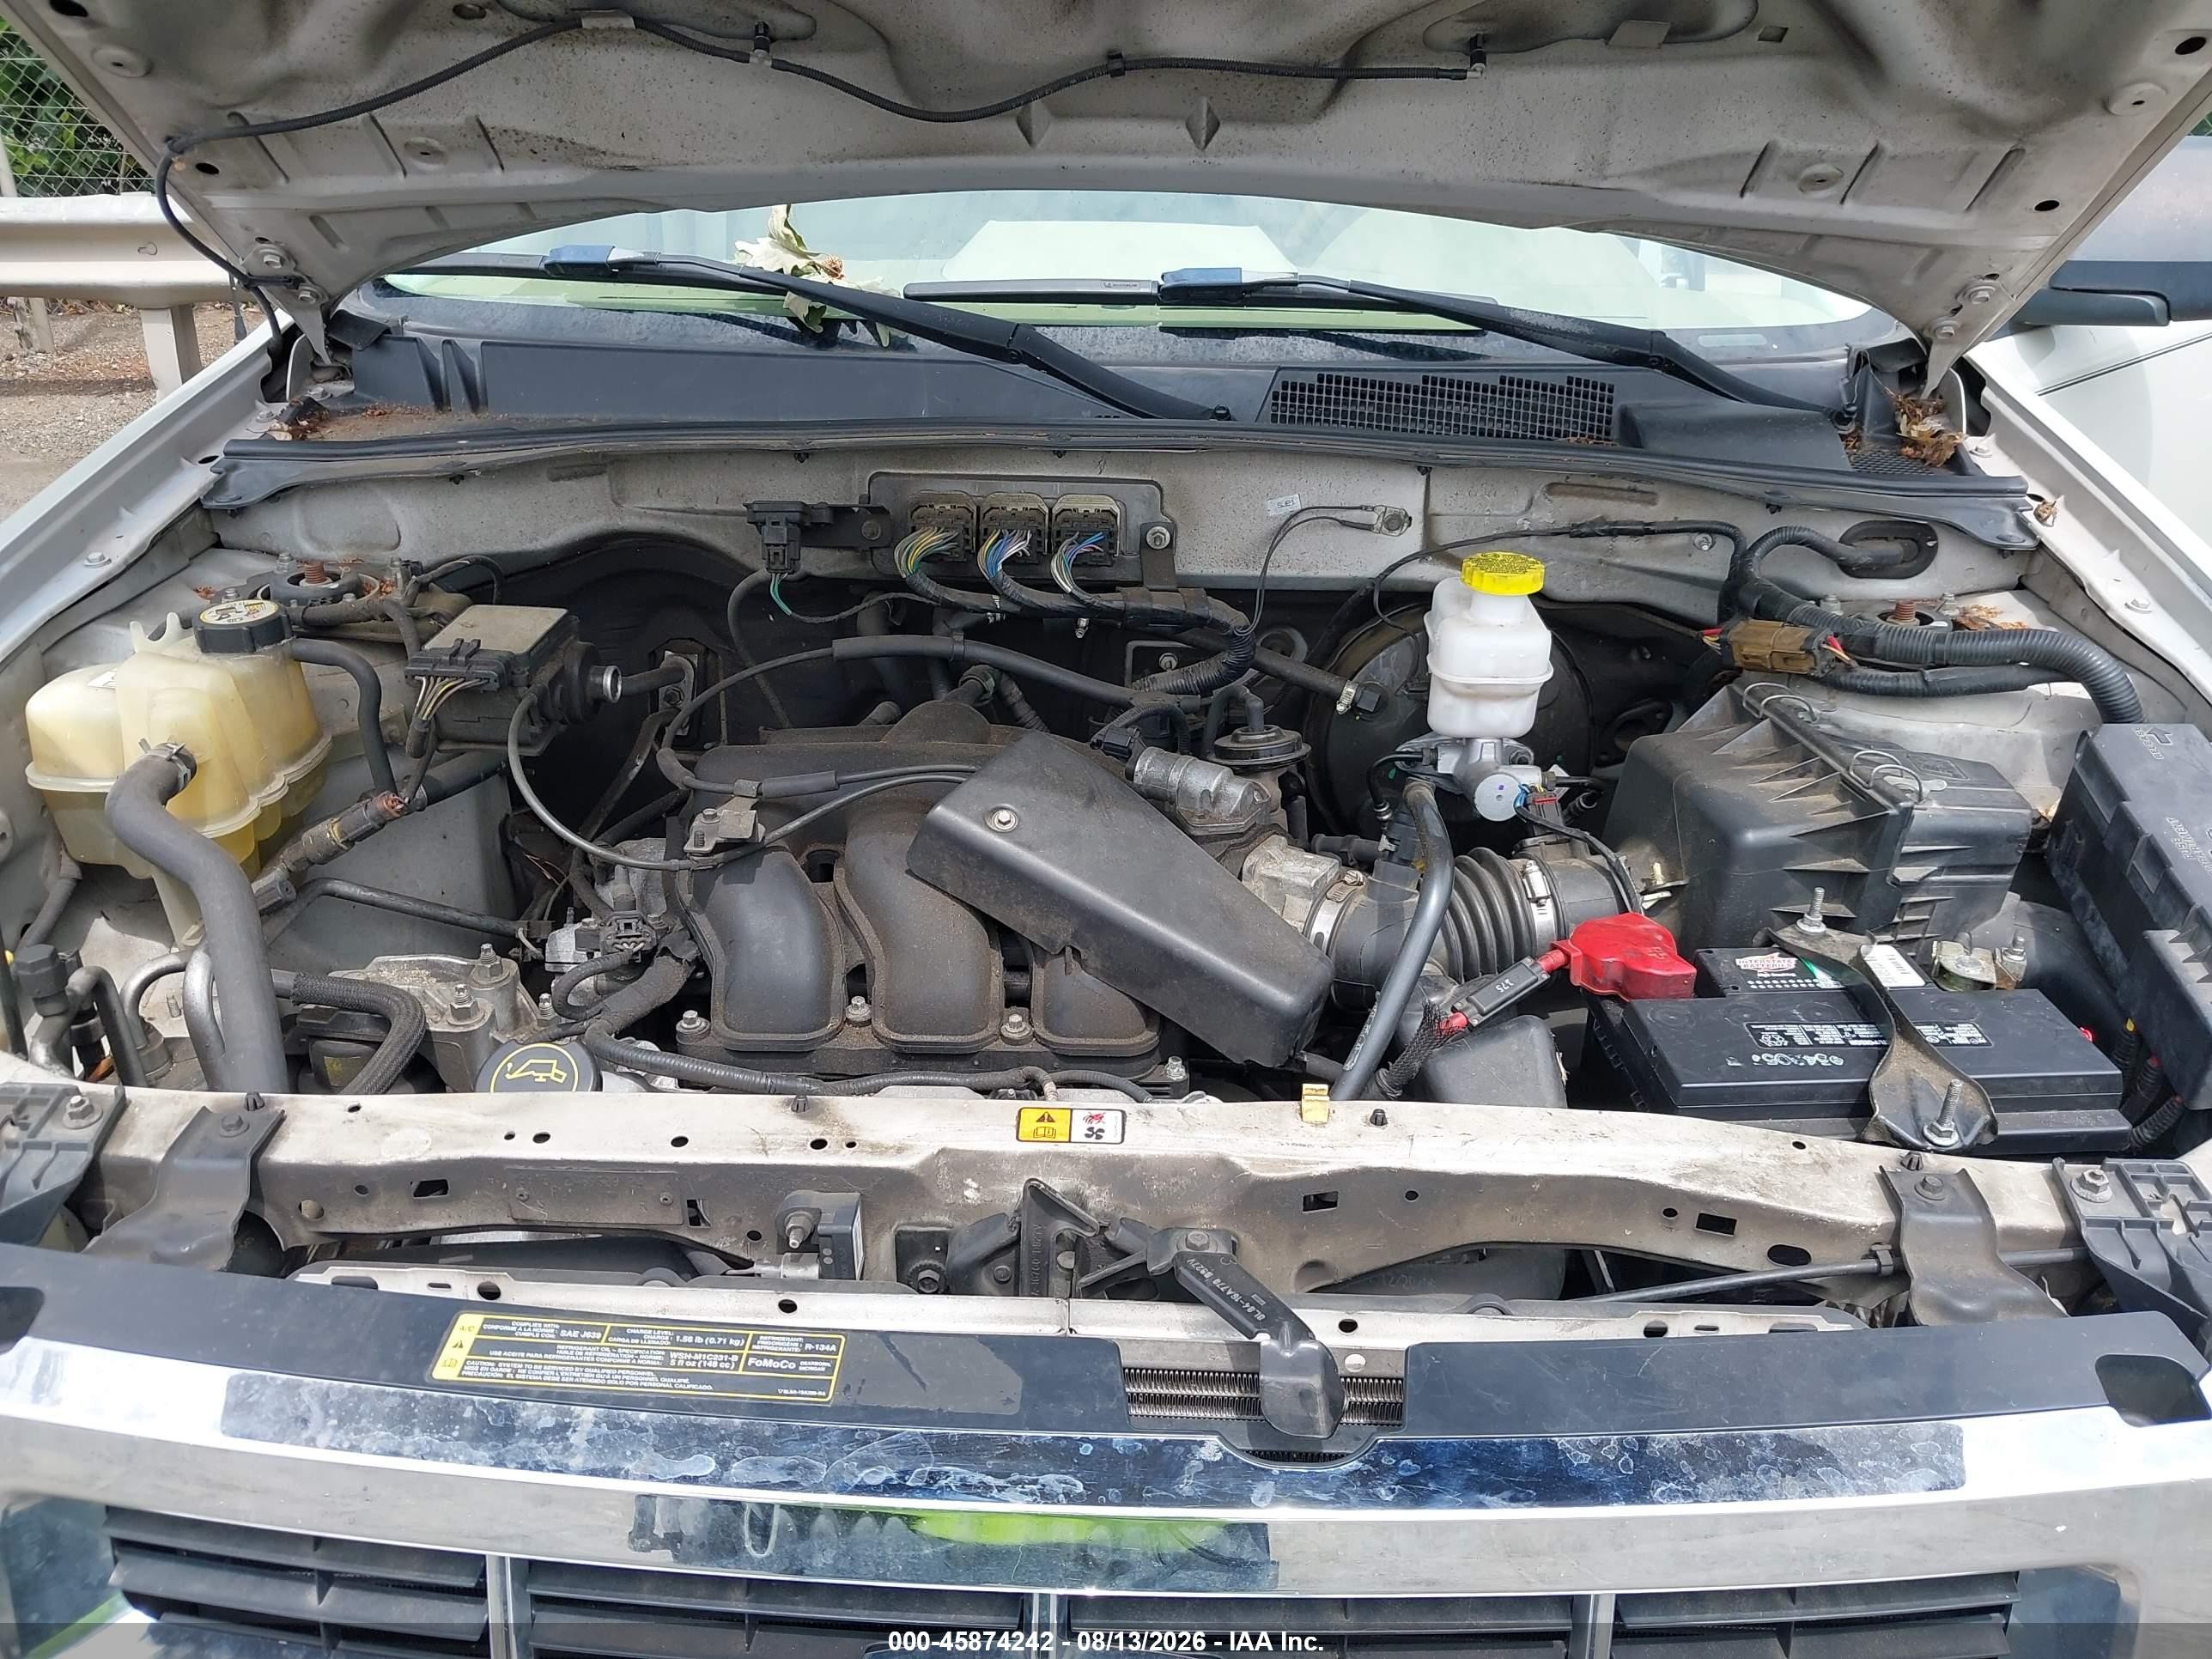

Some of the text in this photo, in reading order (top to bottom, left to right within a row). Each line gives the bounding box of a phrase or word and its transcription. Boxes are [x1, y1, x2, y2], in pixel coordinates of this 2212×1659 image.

[580, 1330, 602, 1340] J639
[676, 1334, 694, 1343] 1.56
[704, 1336, 727, 1346] (0.71
[728, 1337, 745, 1346] kg)
[804, 1343, 837, 1352] R-134A
[670, 1352, 739, 1362] WSH-M1C231-B
[747, 1357, 797, 1370] FoMoCo
